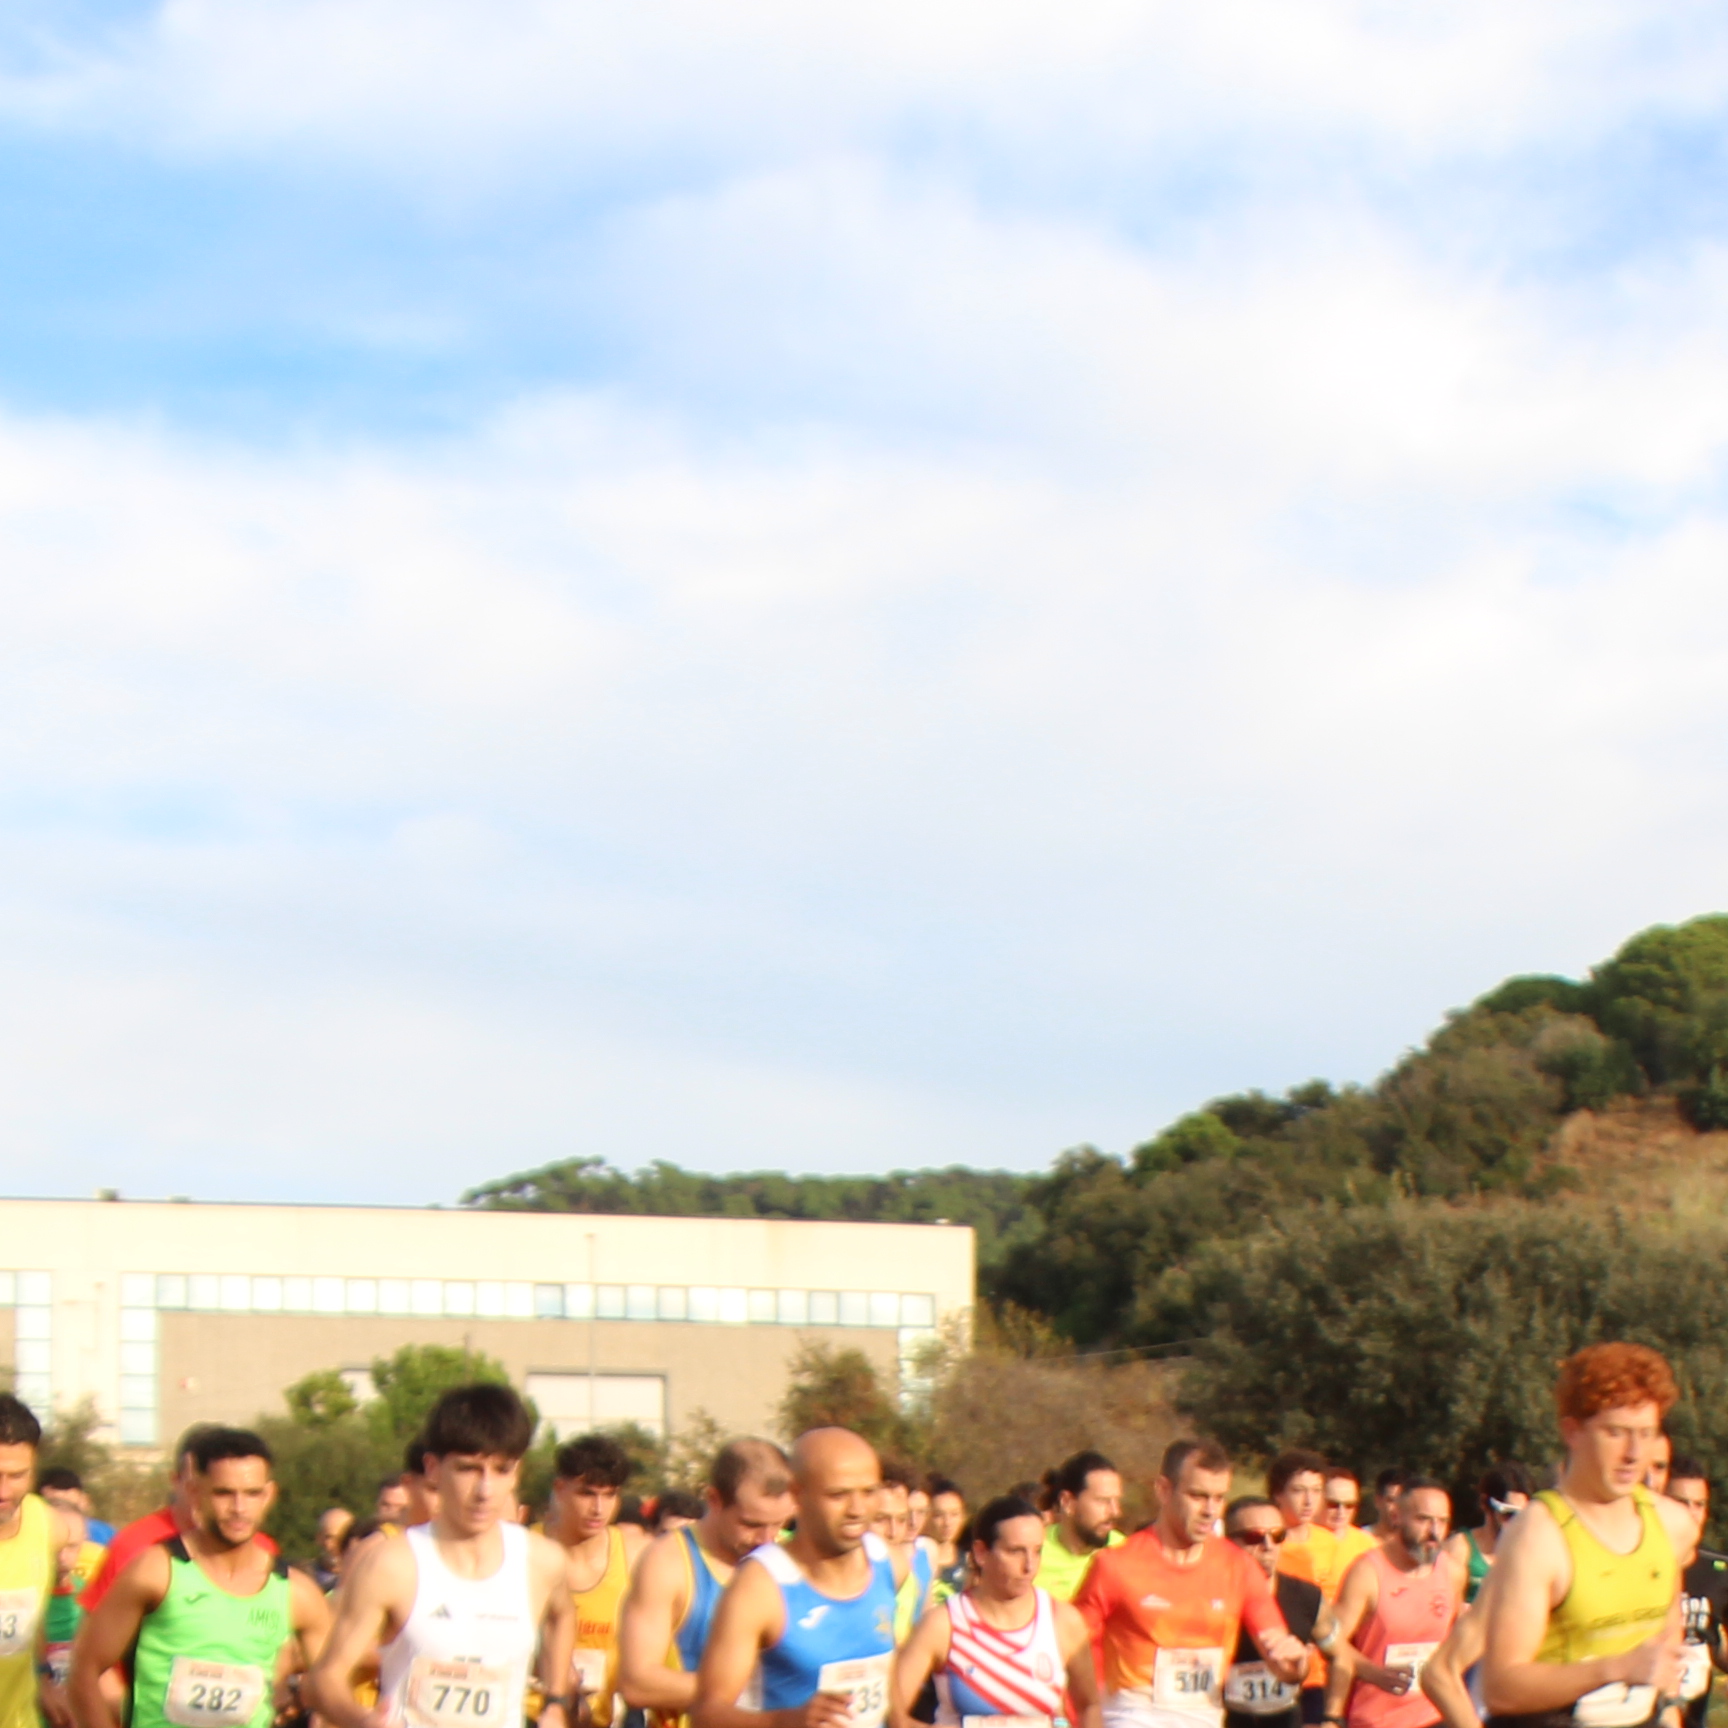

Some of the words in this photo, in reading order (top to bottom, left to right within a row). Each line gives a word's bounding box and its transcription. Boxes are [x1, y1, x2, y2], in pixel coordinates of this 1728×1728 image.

[189, 1684, 242, 1712] 282
[433, 1684, 490, 1716] 770
[847, 1680, 882, 1713] 35
[1243, 1680, 1283, 1701] 314
